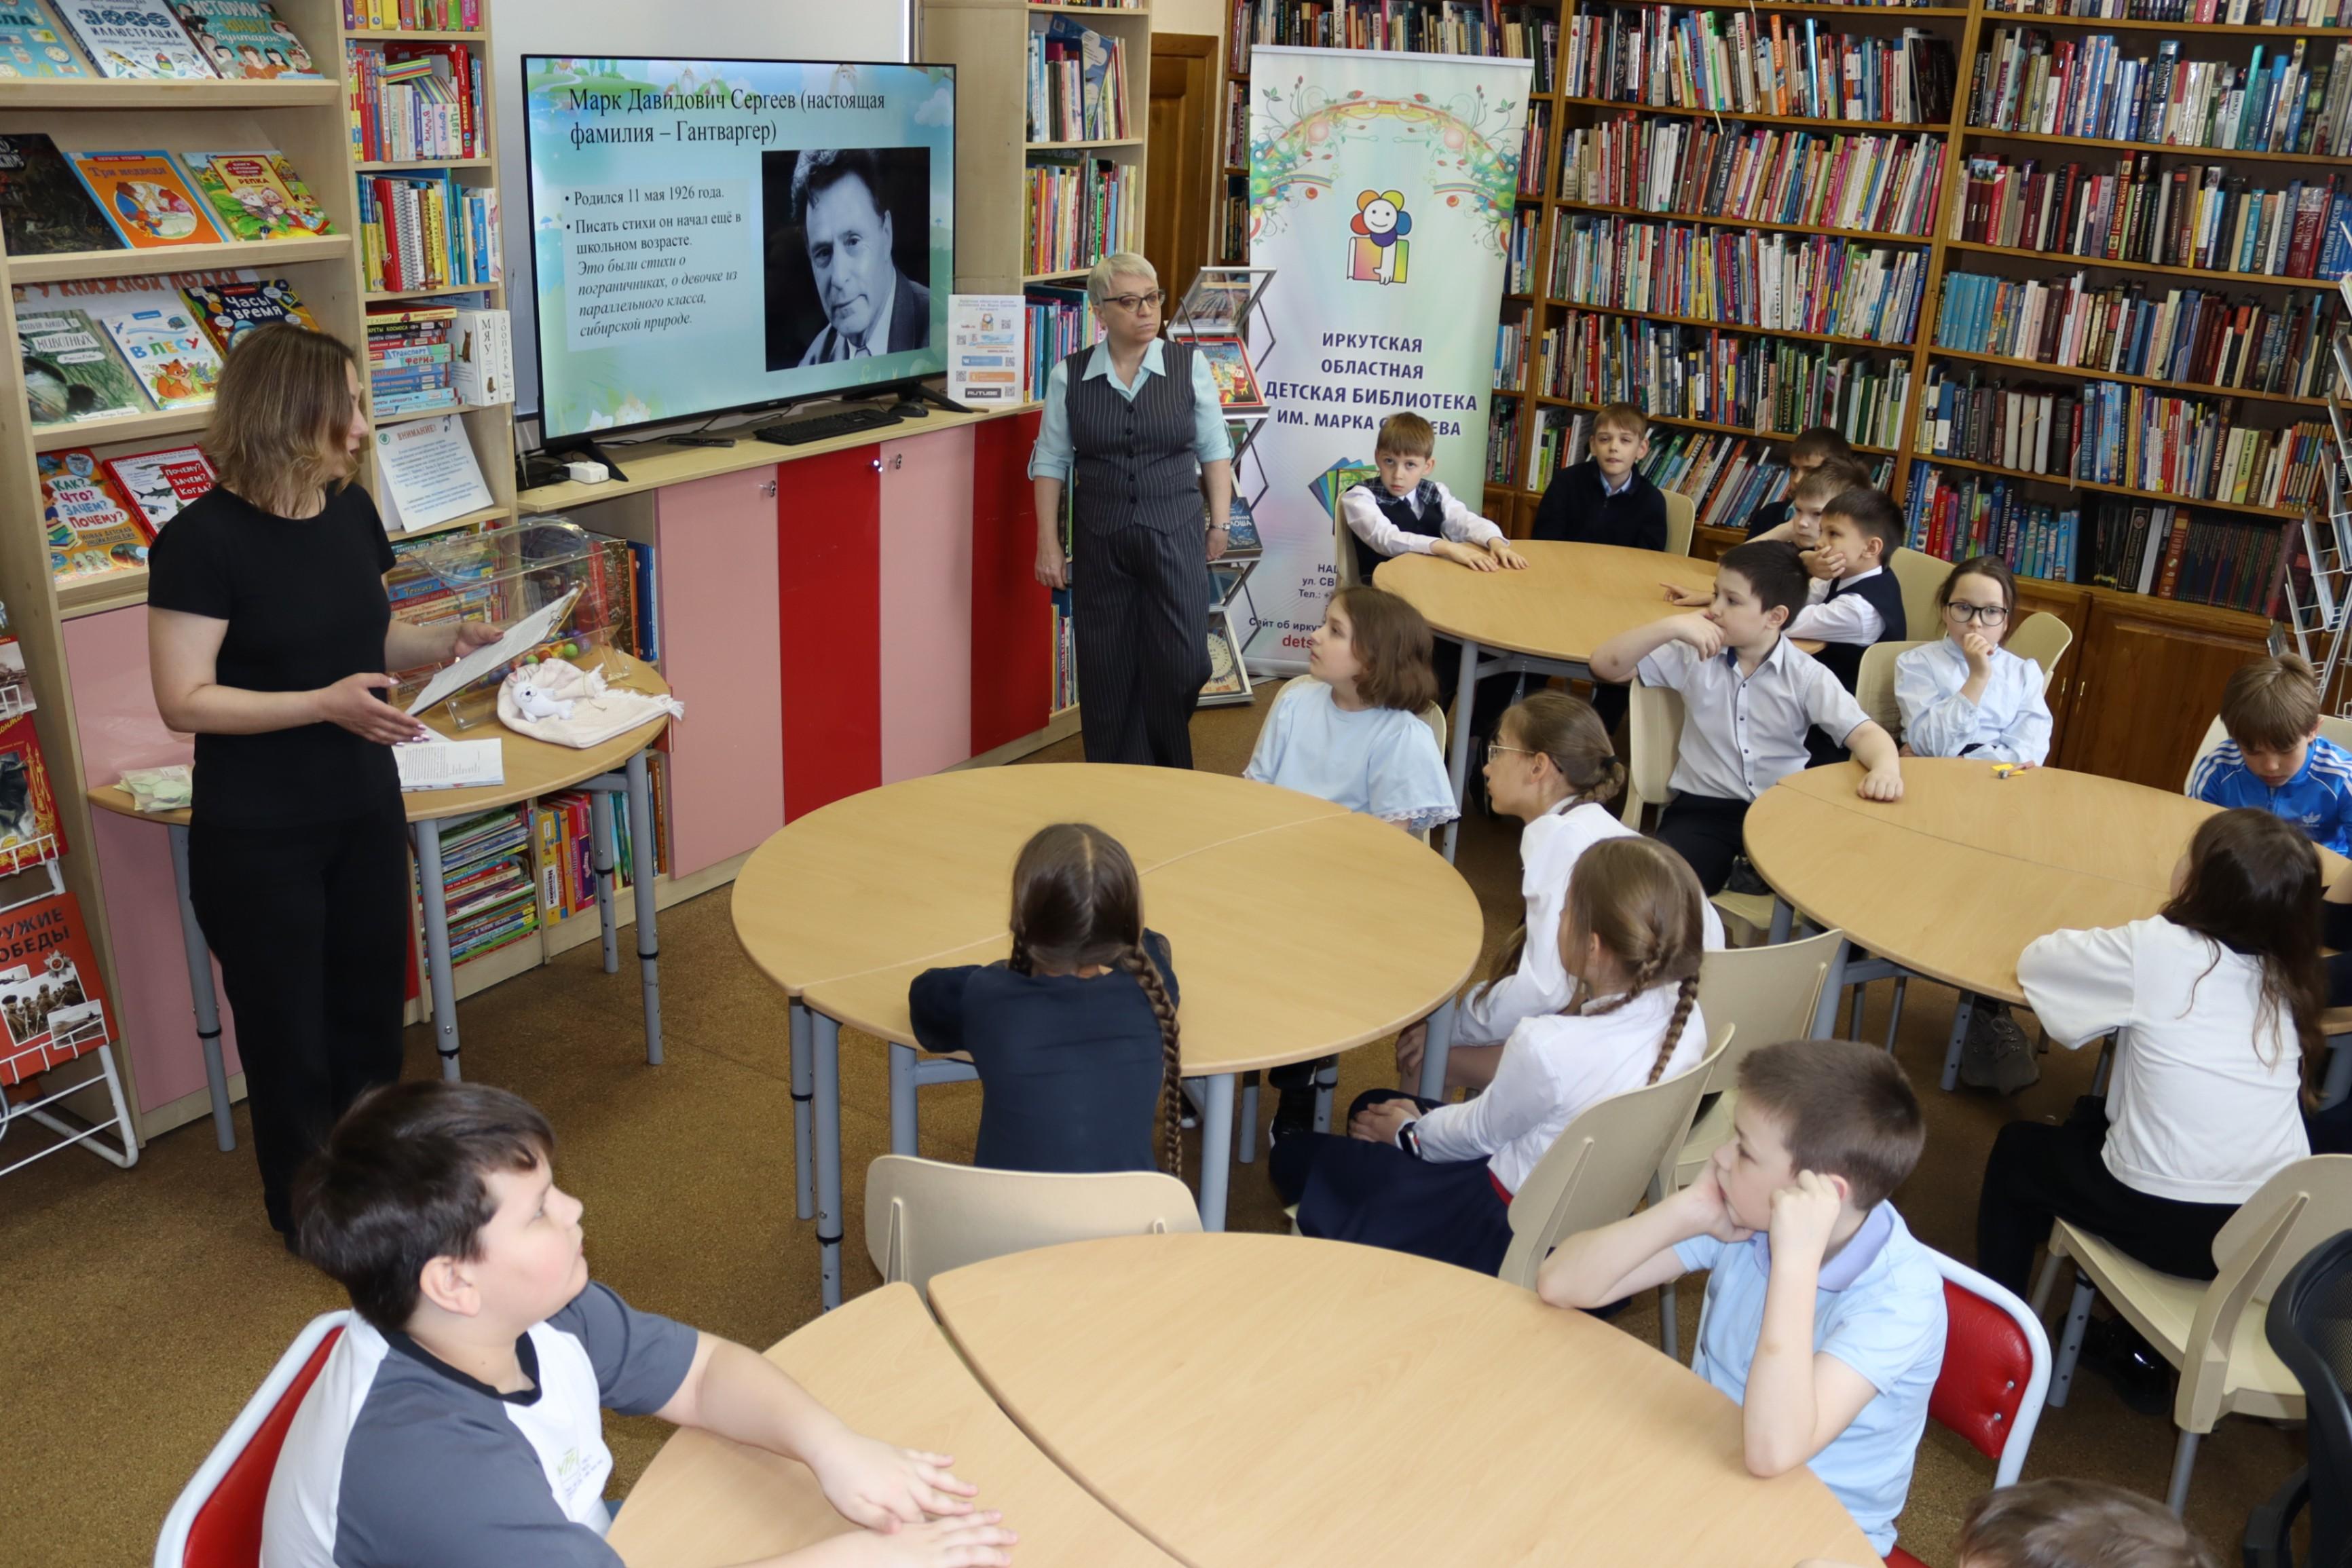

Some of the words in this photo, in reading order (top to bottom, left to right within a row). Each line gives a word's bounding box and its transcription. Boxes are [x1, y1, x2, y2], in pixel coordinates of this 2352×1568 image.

[189, 0, 263, 18] ИСТОРИИ
[90, 26, 181, 39] ИЛЛЮСТРАЦИЙ
[569, 88, 622, 120] Марк
[627, 88, 726, 115] Давидович
[730, 88, 796, 115] Сергеев
[800, 92, 885, 114] (настоящая
[570, 123, 655, 150] фамилия
[676, 120, 777, 145] Гантваргер)
[88, 167, 116, 178] Три
[574, 190, 624, 206] Родился
[628, 188, 639, 203] 11
[644, 191, 665, 202] мая
[669, 186, 695, 201] 1926
[698, 187, 724, 201] года.
[2116, 206, 2124, 229] ИСТОРИЯ
[2120, 181, 2129, 203] РОССИИ
[575, 219, 619, 234] Писать
[622, 219, 656, 231] стихи
[659, 219, 673, 229] он
[677, 216, 708, 227] начал
[711, 211, 732, 227] ещё
[736, 213, 741, 223] в
[2328, 200, 2343, 228] РОССИИ
[576, 238, 637, 255] школьном
[641, 236, 692, 252] возрасте.
[2322, 231, 2336, 263] ИСТОРИЯ
[577, 260, 604, 276] Это
[608, 257, 637, 273] были
[640, 255, 675, 270] стихи
[679, 257, 686, 266] о
[578, 278, 668, 297] пограничниках,
[671, 277, 679, 286] о
[681, 270, 723, 286] девочке
[726, 269, 737, 282] из
[579, 295, 664, 318] параллельного
[667, 292, 707, 308] класса,
[580, 318, 641, 338] сибирской
[644, 312, 692, 333] природе.
[481, 318, 491, 355] МЯУ
[1322, 333, 1423, 353] ИРКУТСКАЯ
[130, 346, 147, 358] В
[149, 337, 199, 356] ЛЕСУ
[1321, 358, 1423, 379] ОБЛАСТНАЯ
[1265, 381, 1346, 403] ДЕТСКАЯ
[1352, 389, 1478, 411] БИБЛИОТЕКА
[1277, 410, 1309, 426] ИМ.
[1314, 413, 1373, 430] МАРКА
[397, 424, 437, 441] ВНИМАНИЕ!
[2213, 428, 2225, 470] ДОМОСТРОЙ
[165, 463, 202, 476] ПОЧЕМУ?
[173, 473, 206, 485] ЗАЧЕМ?
[52, 478, 85, 491] КАК?
[59, 489, 94, 503] ЧТО?
[62, 500, 109, 516] ЗАЧЕМ?
[1937, 501, 1945, 519] МИРА
[1999, 508, 2011, 542] СТОЛИЦЫ
[2005, 488, 2013, 507] МИРА
[69, 510, 125, 529] ПОЧЕМУ?
[1935, 523, 1943, 543] АТЛАС
[1299, 589, 1320, 599] Тел.:
[0, 926, 71, 963] ОБЕДЫ
